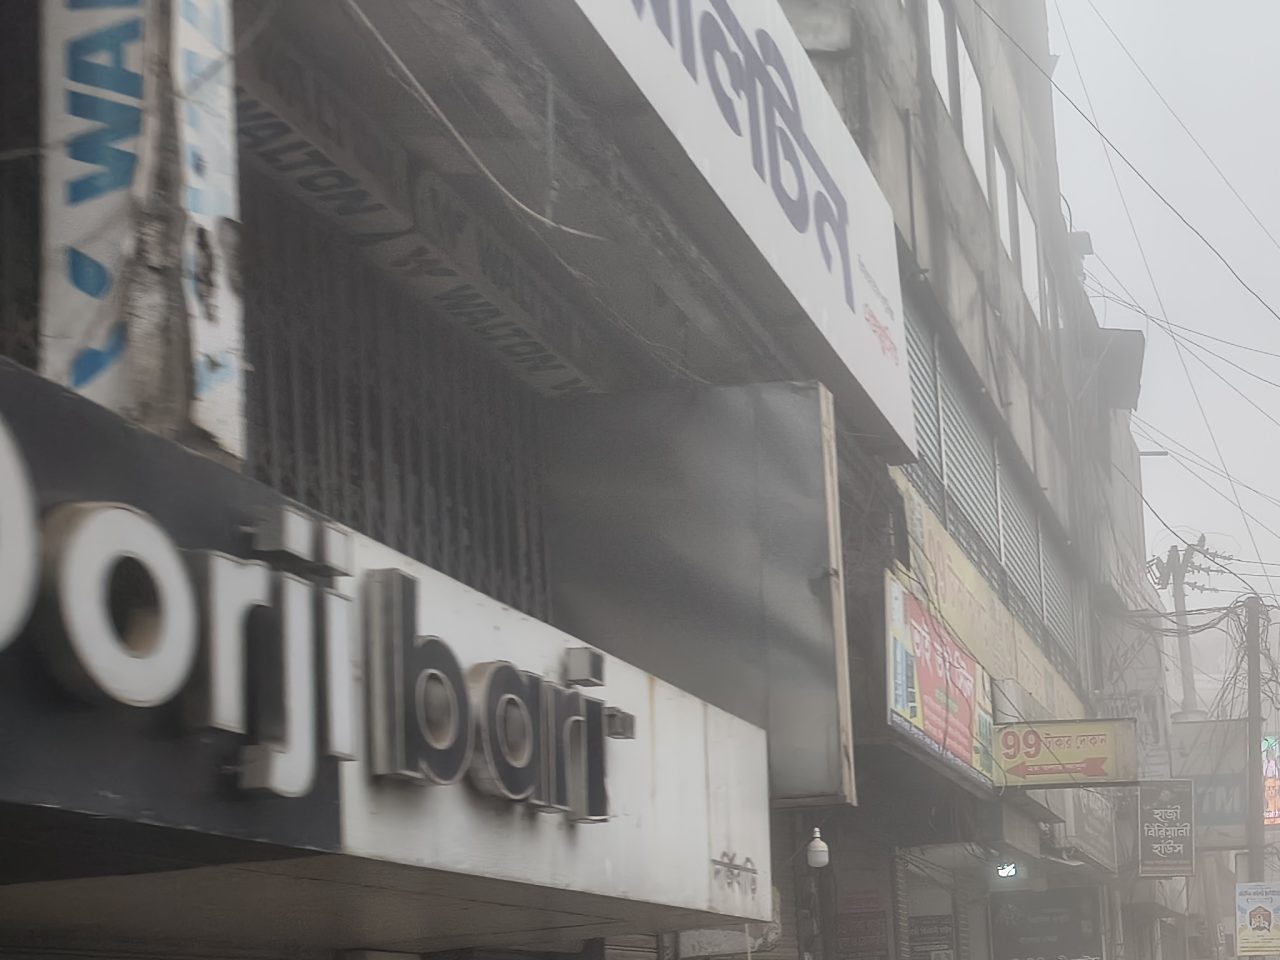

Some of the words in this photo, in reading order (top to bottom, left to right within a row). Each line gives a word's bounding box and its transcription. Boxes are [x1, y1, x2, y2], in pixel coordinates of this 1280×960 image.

[65, 0, 149, 206] WA
[631, 0, 856, 315] ালটন
[366, 566, 610, 825] bari
[1001, 729, 1042, 760] 99
[1152, 805, 1181, 822] হাজী
[1144, 822, 1191, 838] বিরিয়ানী
[1151, 839, 1184, 857] হাউস
